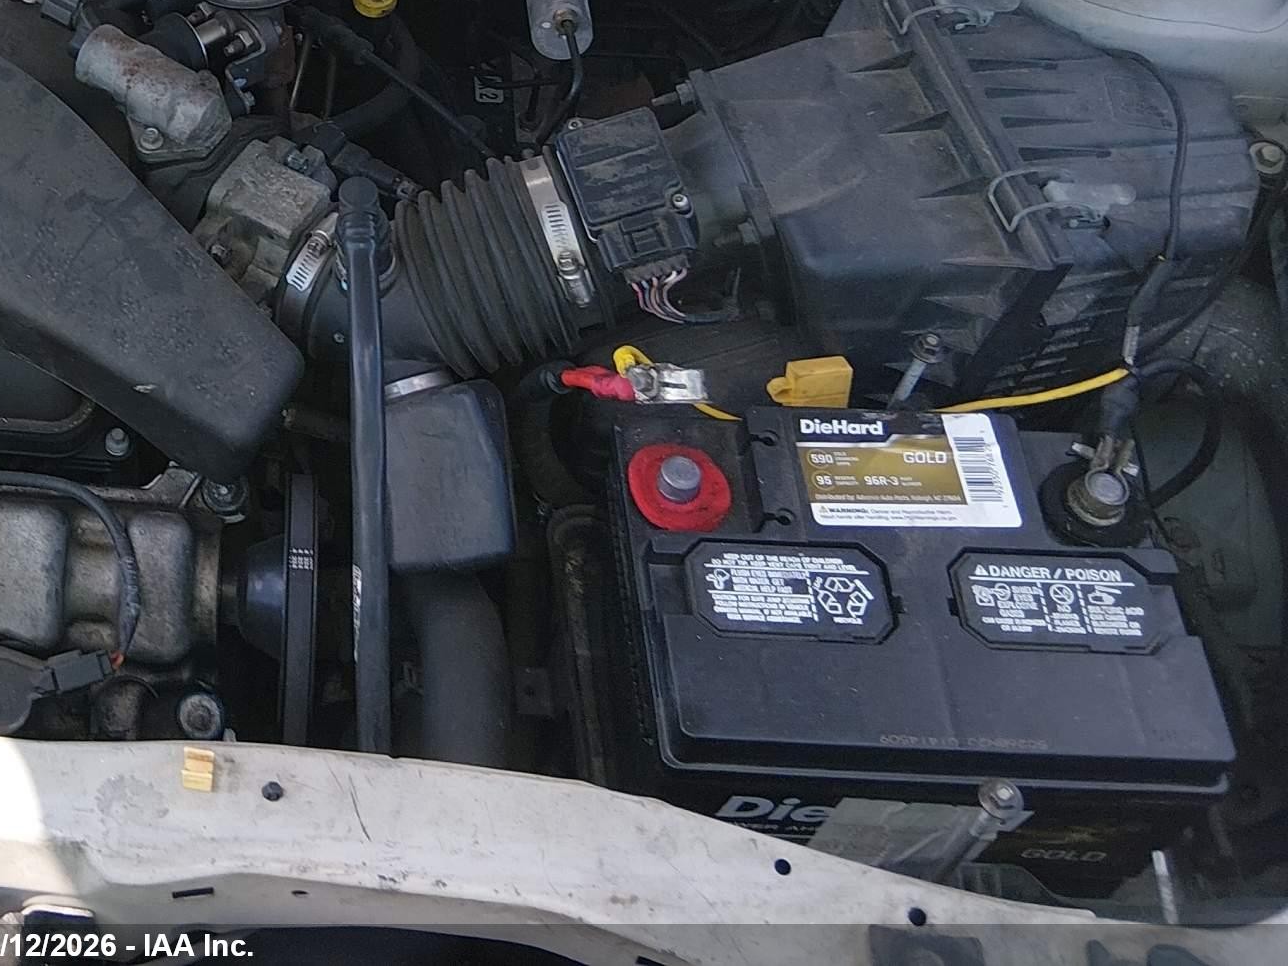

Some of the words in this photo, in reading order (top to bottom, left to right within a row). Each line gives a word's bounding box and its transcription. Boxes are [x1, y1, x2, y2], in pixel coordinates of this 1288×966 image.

[800, 419, 884, 435] DieHard
[811, 453, 834, 465] 590
[903, 452, 948, 464] GOLD
[815, 475, 832, 486] 95
[864, 475, 900, 487] 96R-3
[989, 565, 1051, 579] DANGER
[1053, 568, 1062, 579] /
[1064, 568, 1122, 582] POISON
[1020, 848, 1108, 863] GOLD
